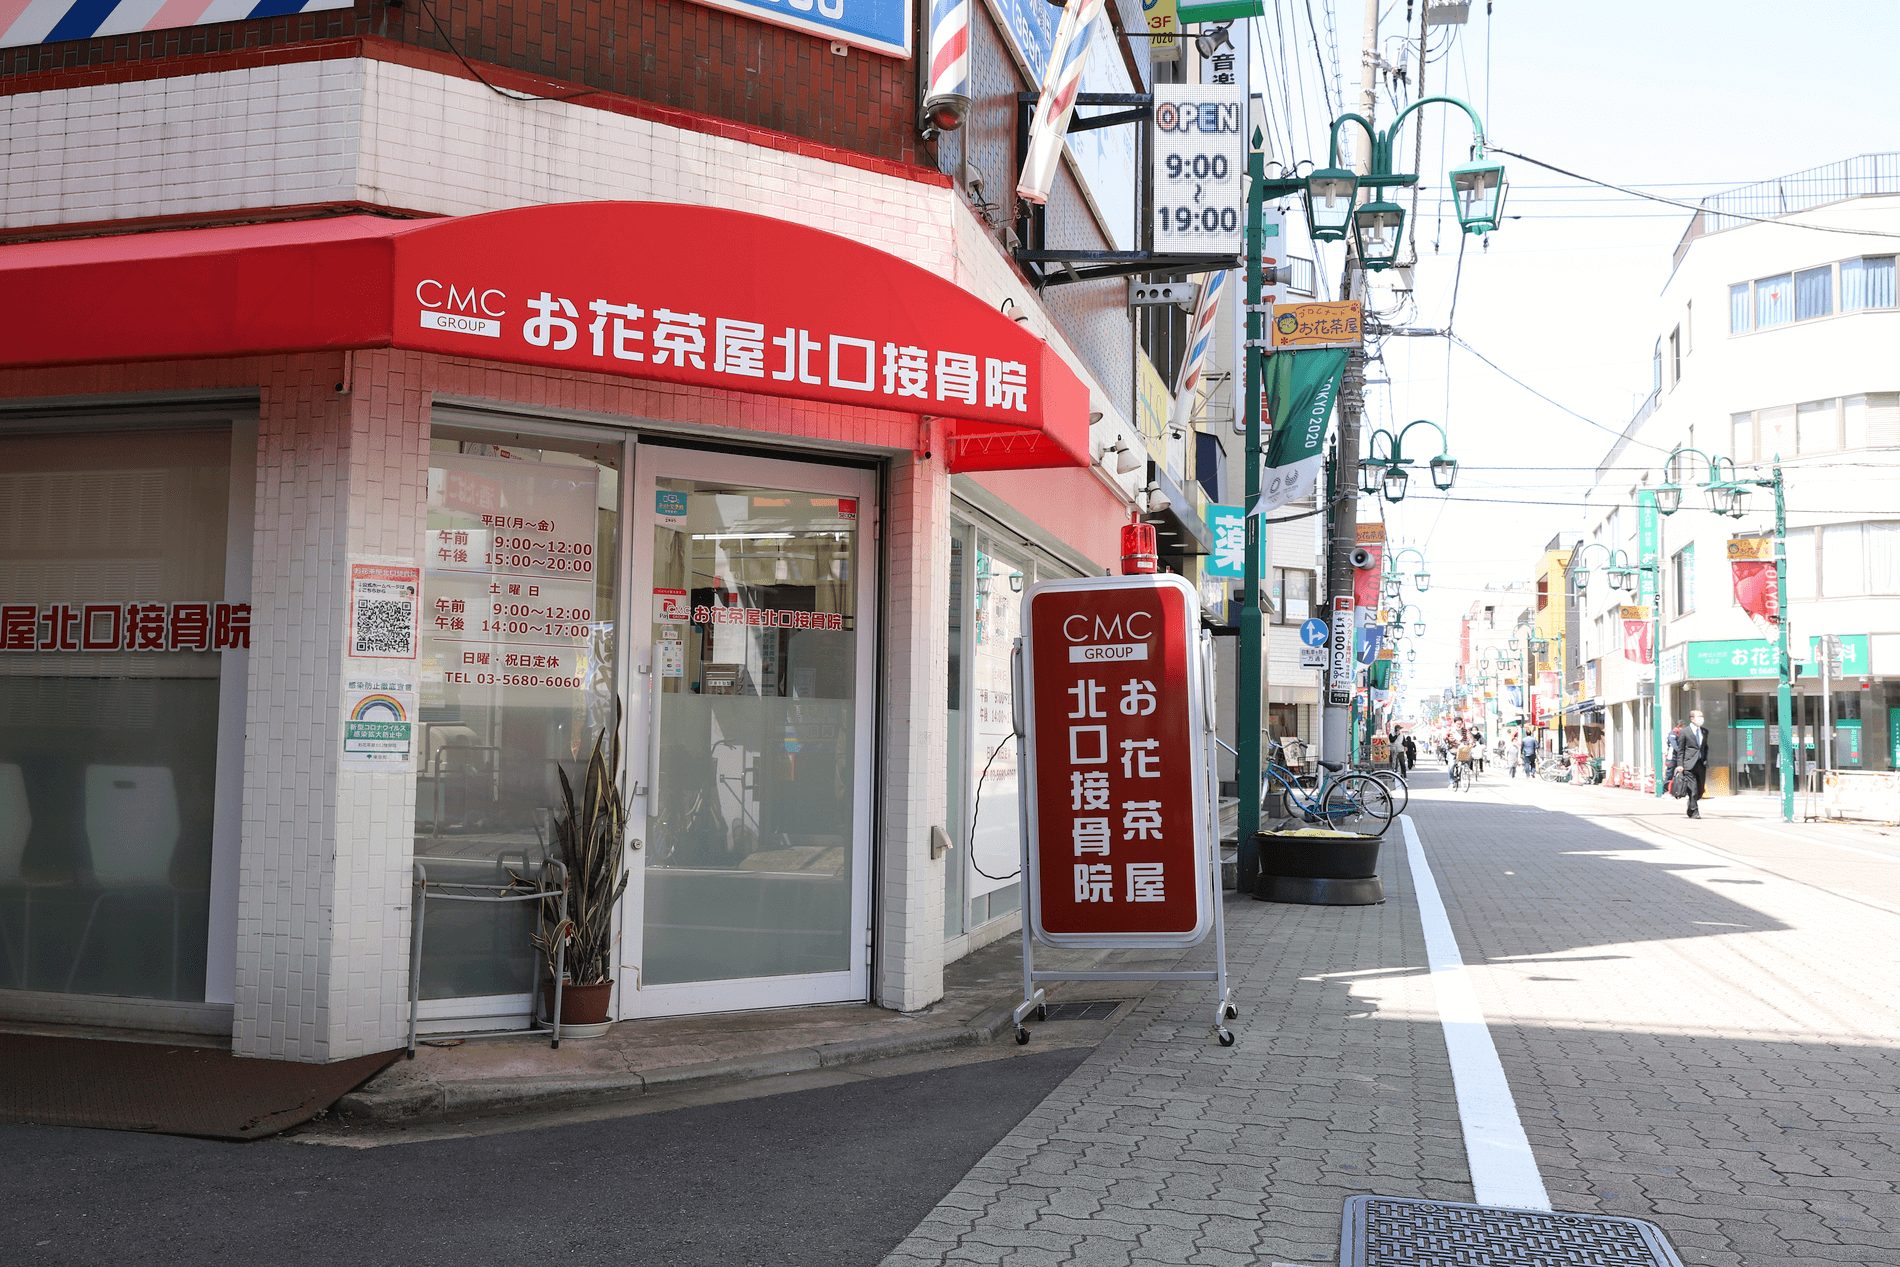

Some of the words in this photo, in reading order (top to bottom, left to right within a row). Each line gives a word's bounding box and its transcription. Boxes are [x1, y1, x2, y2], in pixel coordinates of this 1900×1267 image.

[1156, 102, 1240, 133] OPEN
[1166, 153, 1228, 179] 9:00
[1158, 206, 1238, 232] 19:00
[416, 279, 506, 317] CMC
[437, 316, 486, 332] GROUP
[1300, 318, 1358, 335] お花茶屋
[522, 291, 1027, 412] お花茶屋北口接骨院
[1312, 376, 1334, 415] TOKYO
[1305, 418, 1323, 448] 2020
[438, 530, 469, 545] 午前
[437, 548, 468, 563] 午後
[435, 598, 465, 613] 午前
[693, 605, 843, 631] お花茶屋北口接骨院
[0, 602, 252, 651] 屋北口接骨院
[435, 616, 465, 631] 午後
[1063, 611, 1153, 642] CMC
[1084, 647, 1133, 660] GROUP
[445, 672, 471, 684] TEL
[477, 673, 581, 688] 03-5680-6060
[1067, 679, 1114, 903] 北口接骨院
[1119, 678, 1166, 903] お花茶屋
